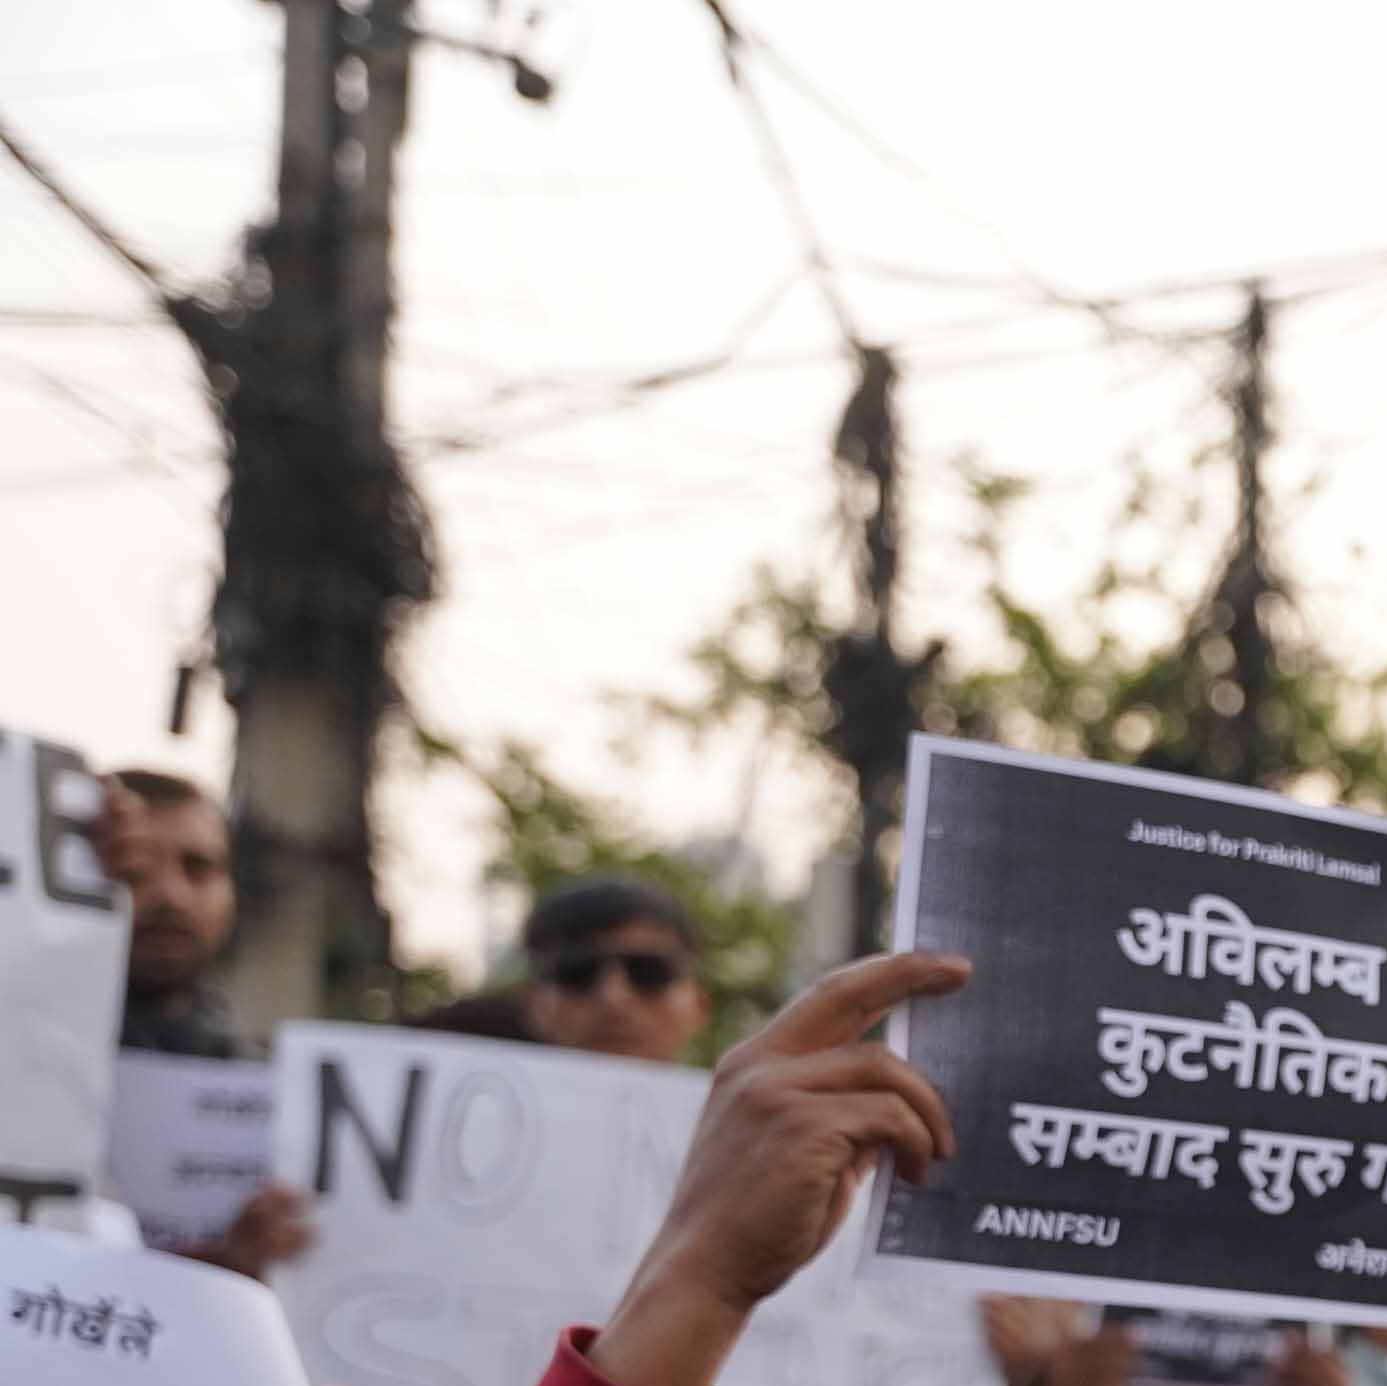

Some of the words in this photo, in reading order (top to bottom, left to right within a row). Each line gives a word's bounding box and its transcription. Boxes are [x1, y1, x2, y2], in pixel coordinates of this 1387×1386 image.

[1127, 818, 1204, 854] Justice
[1206, 834, 1240, 859] for
[1243, 838, 1315, 873] Prakriti
[1316, 855, 1382, 887] Lamsal
[1115, 891, 1387, 1006] अविलम्ब
[1007, 1101, 1229, 1190] सम्बाद
[1239, 1128, 1353, 1215] सुरु
[975, 1204, 1121, 1249] ANNFSU
